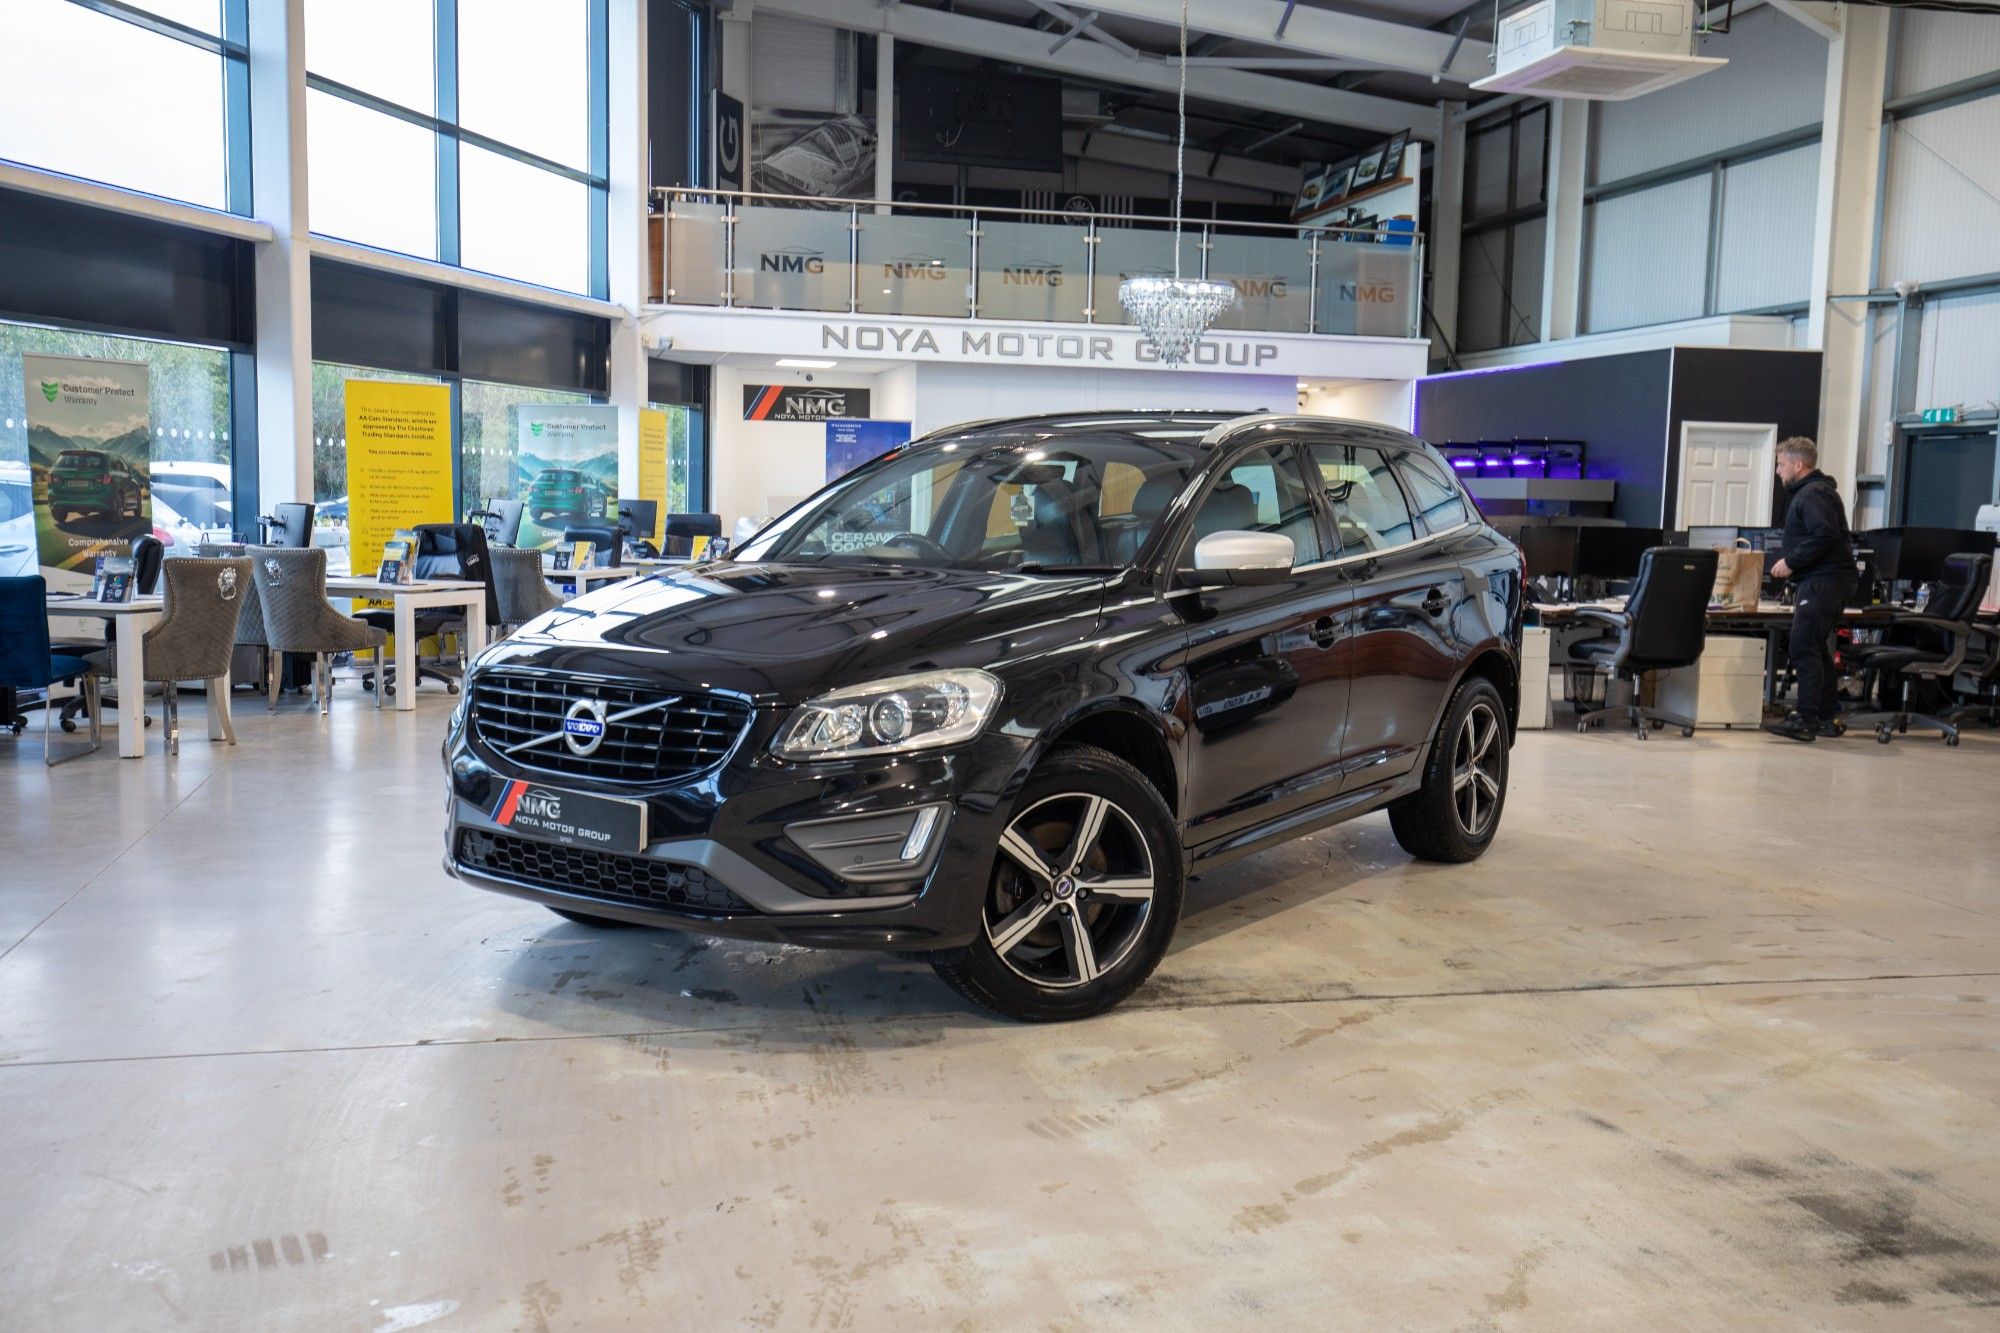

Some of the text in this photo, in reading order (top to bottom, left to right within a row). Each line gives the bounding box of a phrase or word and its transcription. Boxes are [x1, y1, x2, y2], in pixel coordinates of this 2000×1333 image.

[760, 253, 824, 274] NMG
[884, 263, 946, 280] NMG
[1003, 268, 1063, 286] NMG
[1231, 279, 1288, 298] NMG
[1340, 283, 1394, 303] NMG
[822, 325, 940, 353] NOYA
[962, 331, 1113, 361] MOTOR
[63, 384, 135, 397] Customer Protect
[63, 396, 97, 405] Warranty
[785, 397, 846, 415] NMG
[547, 423, 579, 431] Customer
[68, 537, 129, 547] Comprehensive
[82, 549, 117, 557] Warranty
[566, 721, 600, 734] VOLVO
[515, 795, 561, 819] NMG
[515, 814, 539, 827] NOYA
[542, 821, 575, 835] MOTOR
[577, 828, 611, 841] GROUP
